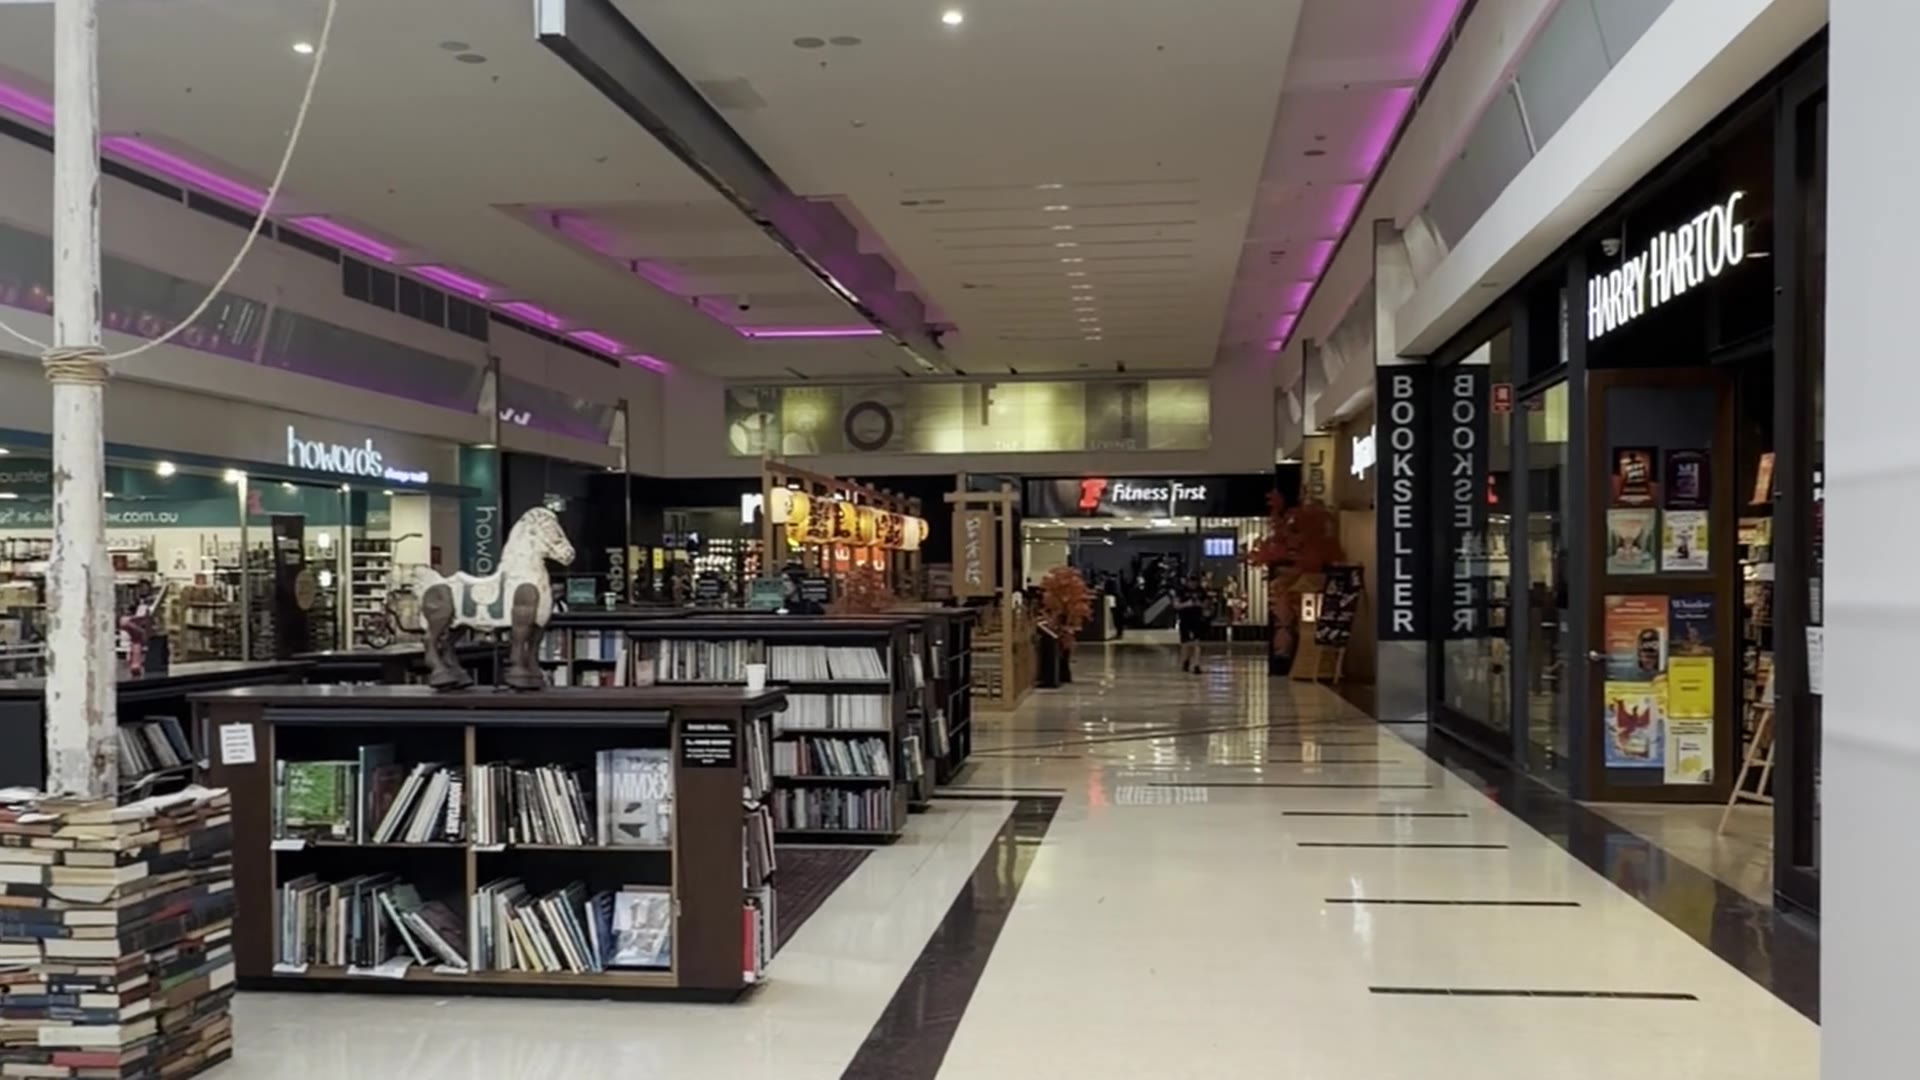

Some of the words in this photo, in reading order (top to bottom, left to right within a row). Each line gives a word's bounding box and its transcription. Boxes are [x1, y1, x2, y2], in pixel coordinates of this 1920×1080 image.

[1588, 251, 1648, 340] HARRY
[1650, 191, 1744, 307] HARTOG
[475, 506, 497, 576] howa
[1391, 376, 1414, 632] BOOKSELLER
